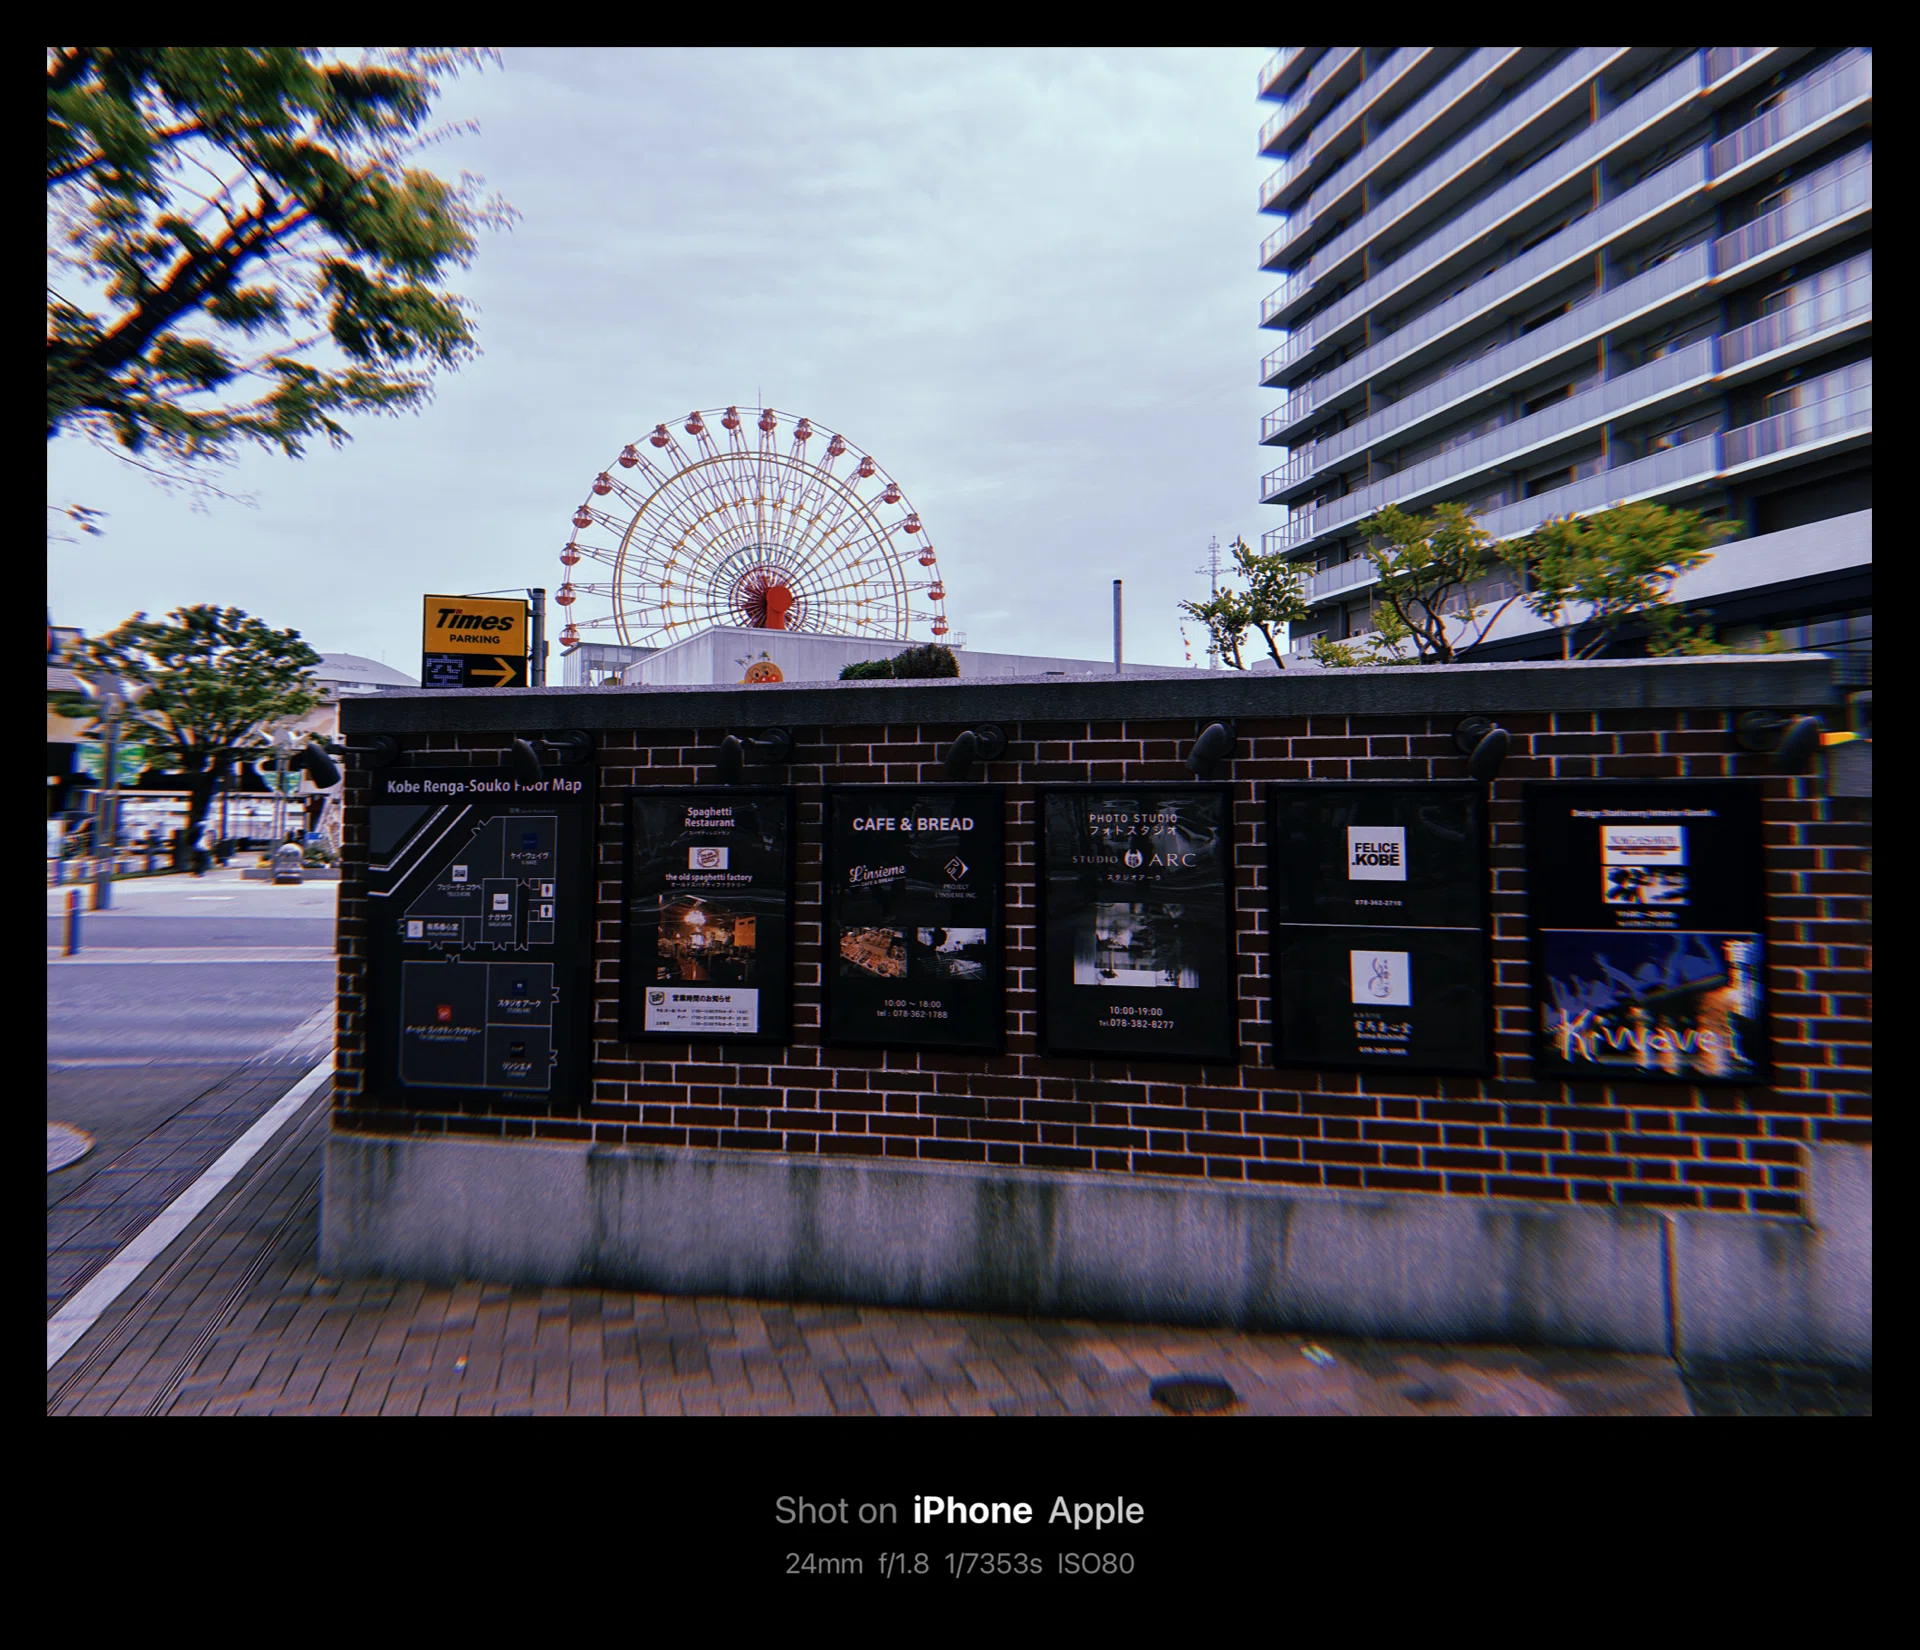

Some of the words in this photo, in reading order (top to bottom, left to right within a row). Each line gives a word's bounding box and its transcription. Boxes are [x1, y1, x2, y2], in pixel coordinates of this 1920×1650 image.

[436, 608, 515, 630] Times
[449, 634, 501, 643] PARKING
[387, 780, 421, 793] Kobe
[423, 779, 511, 795] Renga-Souko
[552, 778, 582, 794] Map
[687, 807, 732, 818] Spaghetti
[684, 818, 735, 828] Restaurant
[1089, 814, 1129, 823] PHOTO
[1133, 814, 1178, 823] STUDIO
[852, 817, 897, 831] CAFE
[900, 817, 913, 831] &
[917, 817, 975, 831] BREAD
[1089, 825, 1177, 836] フォトスタジオ
[1355, 843, 1400, 853] FELICE
[1072, 855, 1118, 864] STUDIO
[1148, 853, 1197, 867] ARC
[1351, 854, 1400, 866] .KOBE
[691, 874, 725, 882] spaghetti
[727, 873, 753, 882] factory
[672, 995, 732, 1003] 営業時間のお知らせ
[884, 999, 907, 1008] 10:00
[919, 1000, 942, 1009] 18:00
[1109, 1006, 1163, 1016] 10:00-19:00
